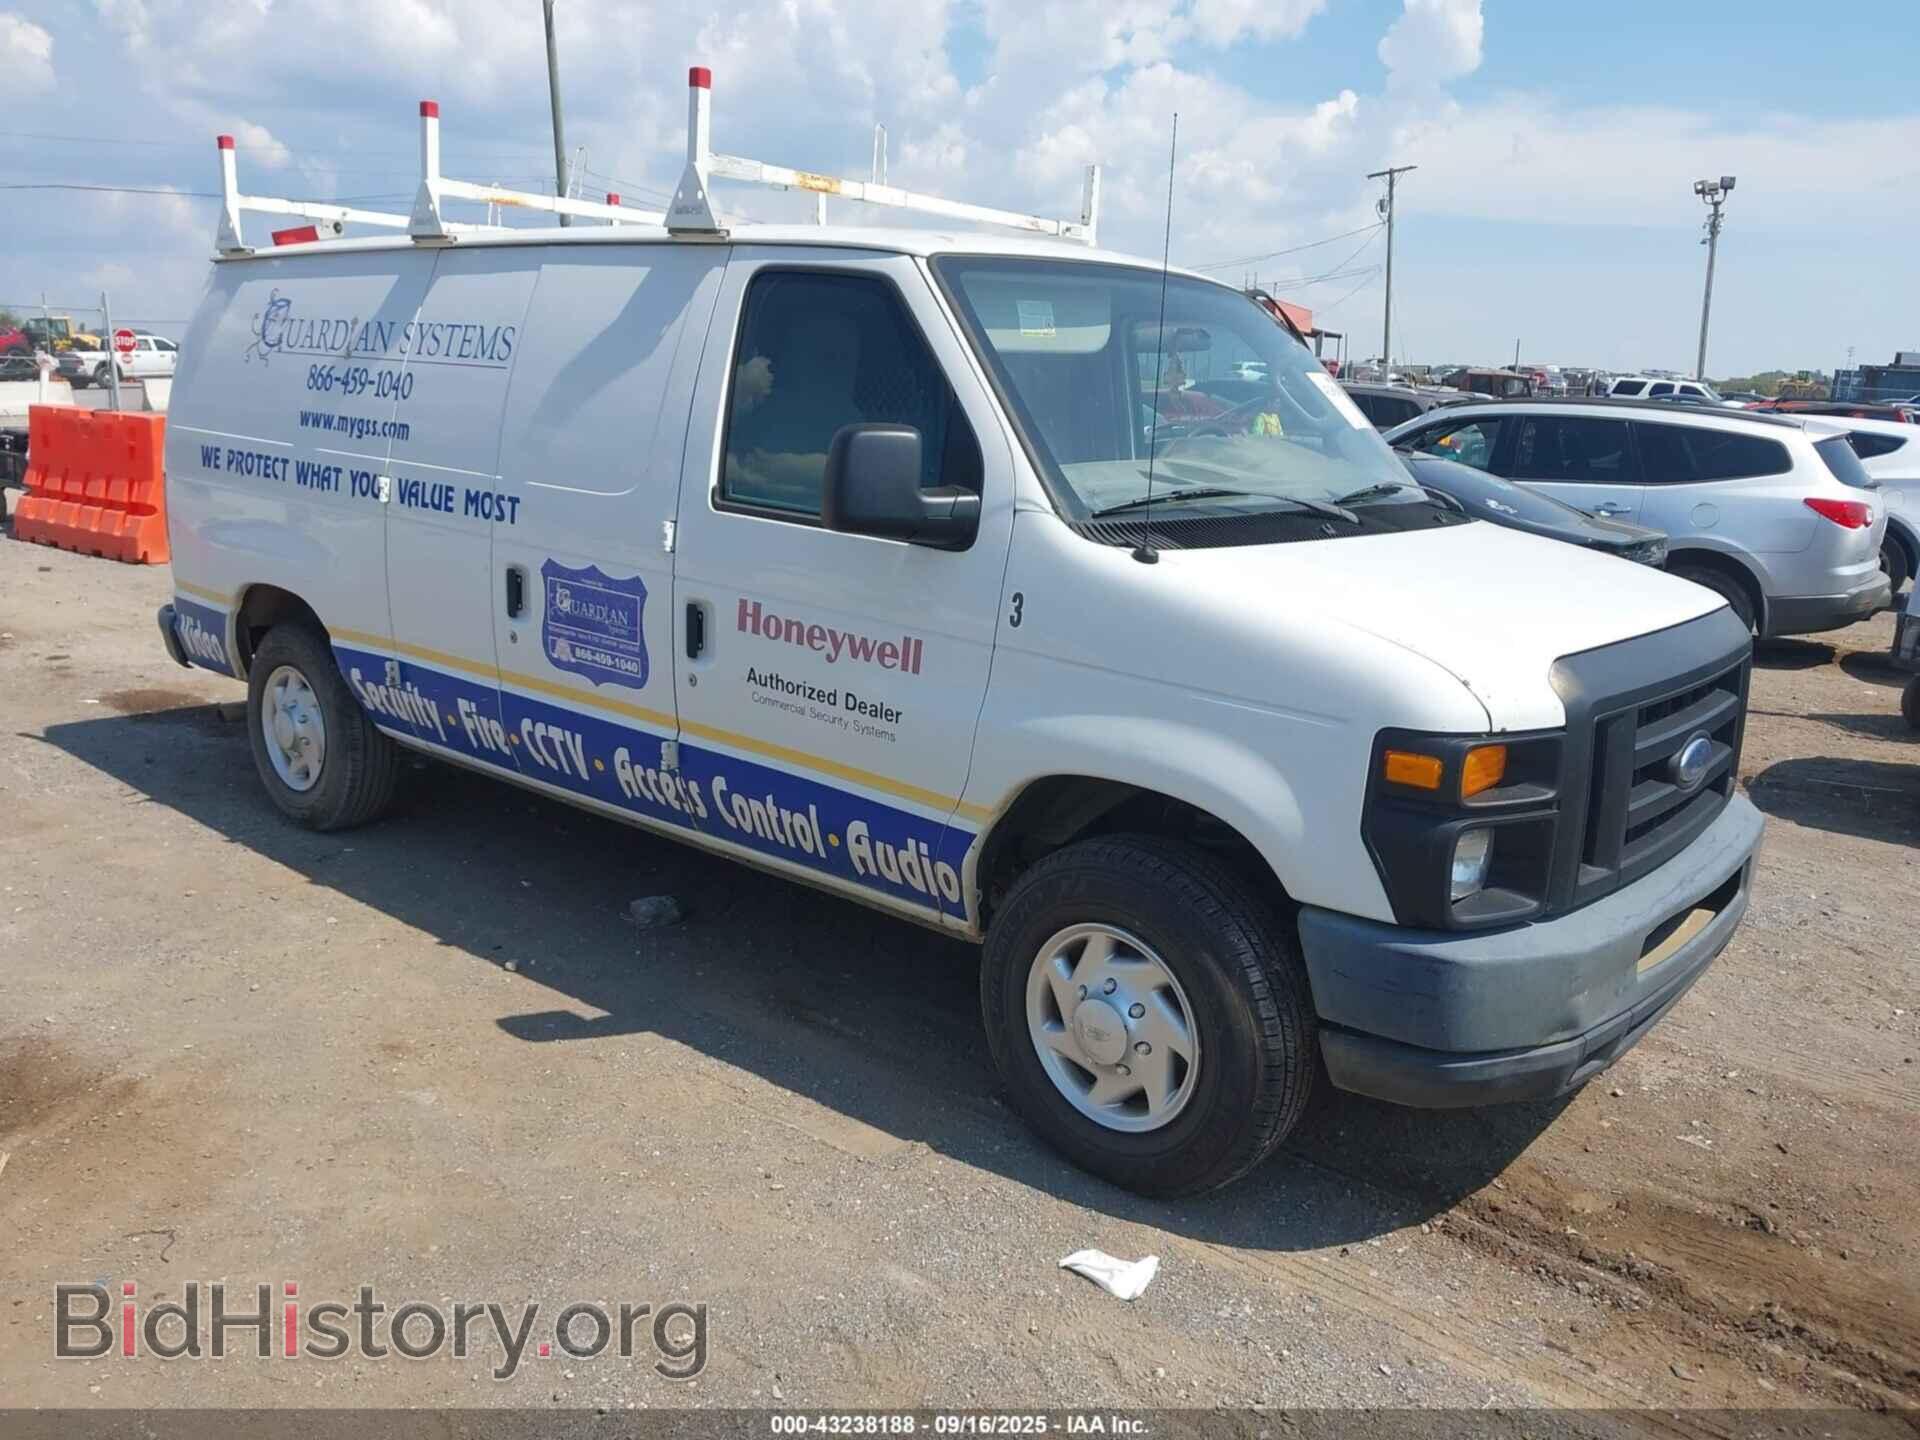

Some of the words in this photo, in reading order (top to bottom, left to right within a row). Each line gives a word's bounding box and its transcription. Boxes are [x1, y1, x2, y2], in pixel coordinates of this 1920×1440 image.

[115, 336, 135, 346] STOP
[261, 297, 396, 357] GUARDIAN
[402, 320, 516, 362] SYSTEMS
[306, 364, 414, 401] 866-459-1040
[299, 409, 411, 442] www.mygss.com
[200, 444, 221, 470] WE
[226, 450, 290, 483] PROTECT
[295, 460, 343, 492] WHAT
[398, 478, 455, 514] VALUE
[464, 488, 521, 525] MOST
[736, 597, 924, 675] Honeywell
[1008, 591, 1024, 628] 3
[179, 612, 226, 665] Video
[746, 667, 838, 706] Authorized
[844, 692, 903, 724] Dealer
[751, 691, 806, 716] Commercial
[809, 704, 849, 730] Security
[853, 719, 896, 742] Systems
[351, 667, 448, 742] Security
[457, 697, 511, 755] Fire
[520, 717, 590, 781] CCTV
[613, 746, 708, 819] Access
[711, 775, 827, 859] Control
[846, 820, 962, 904] Audio
